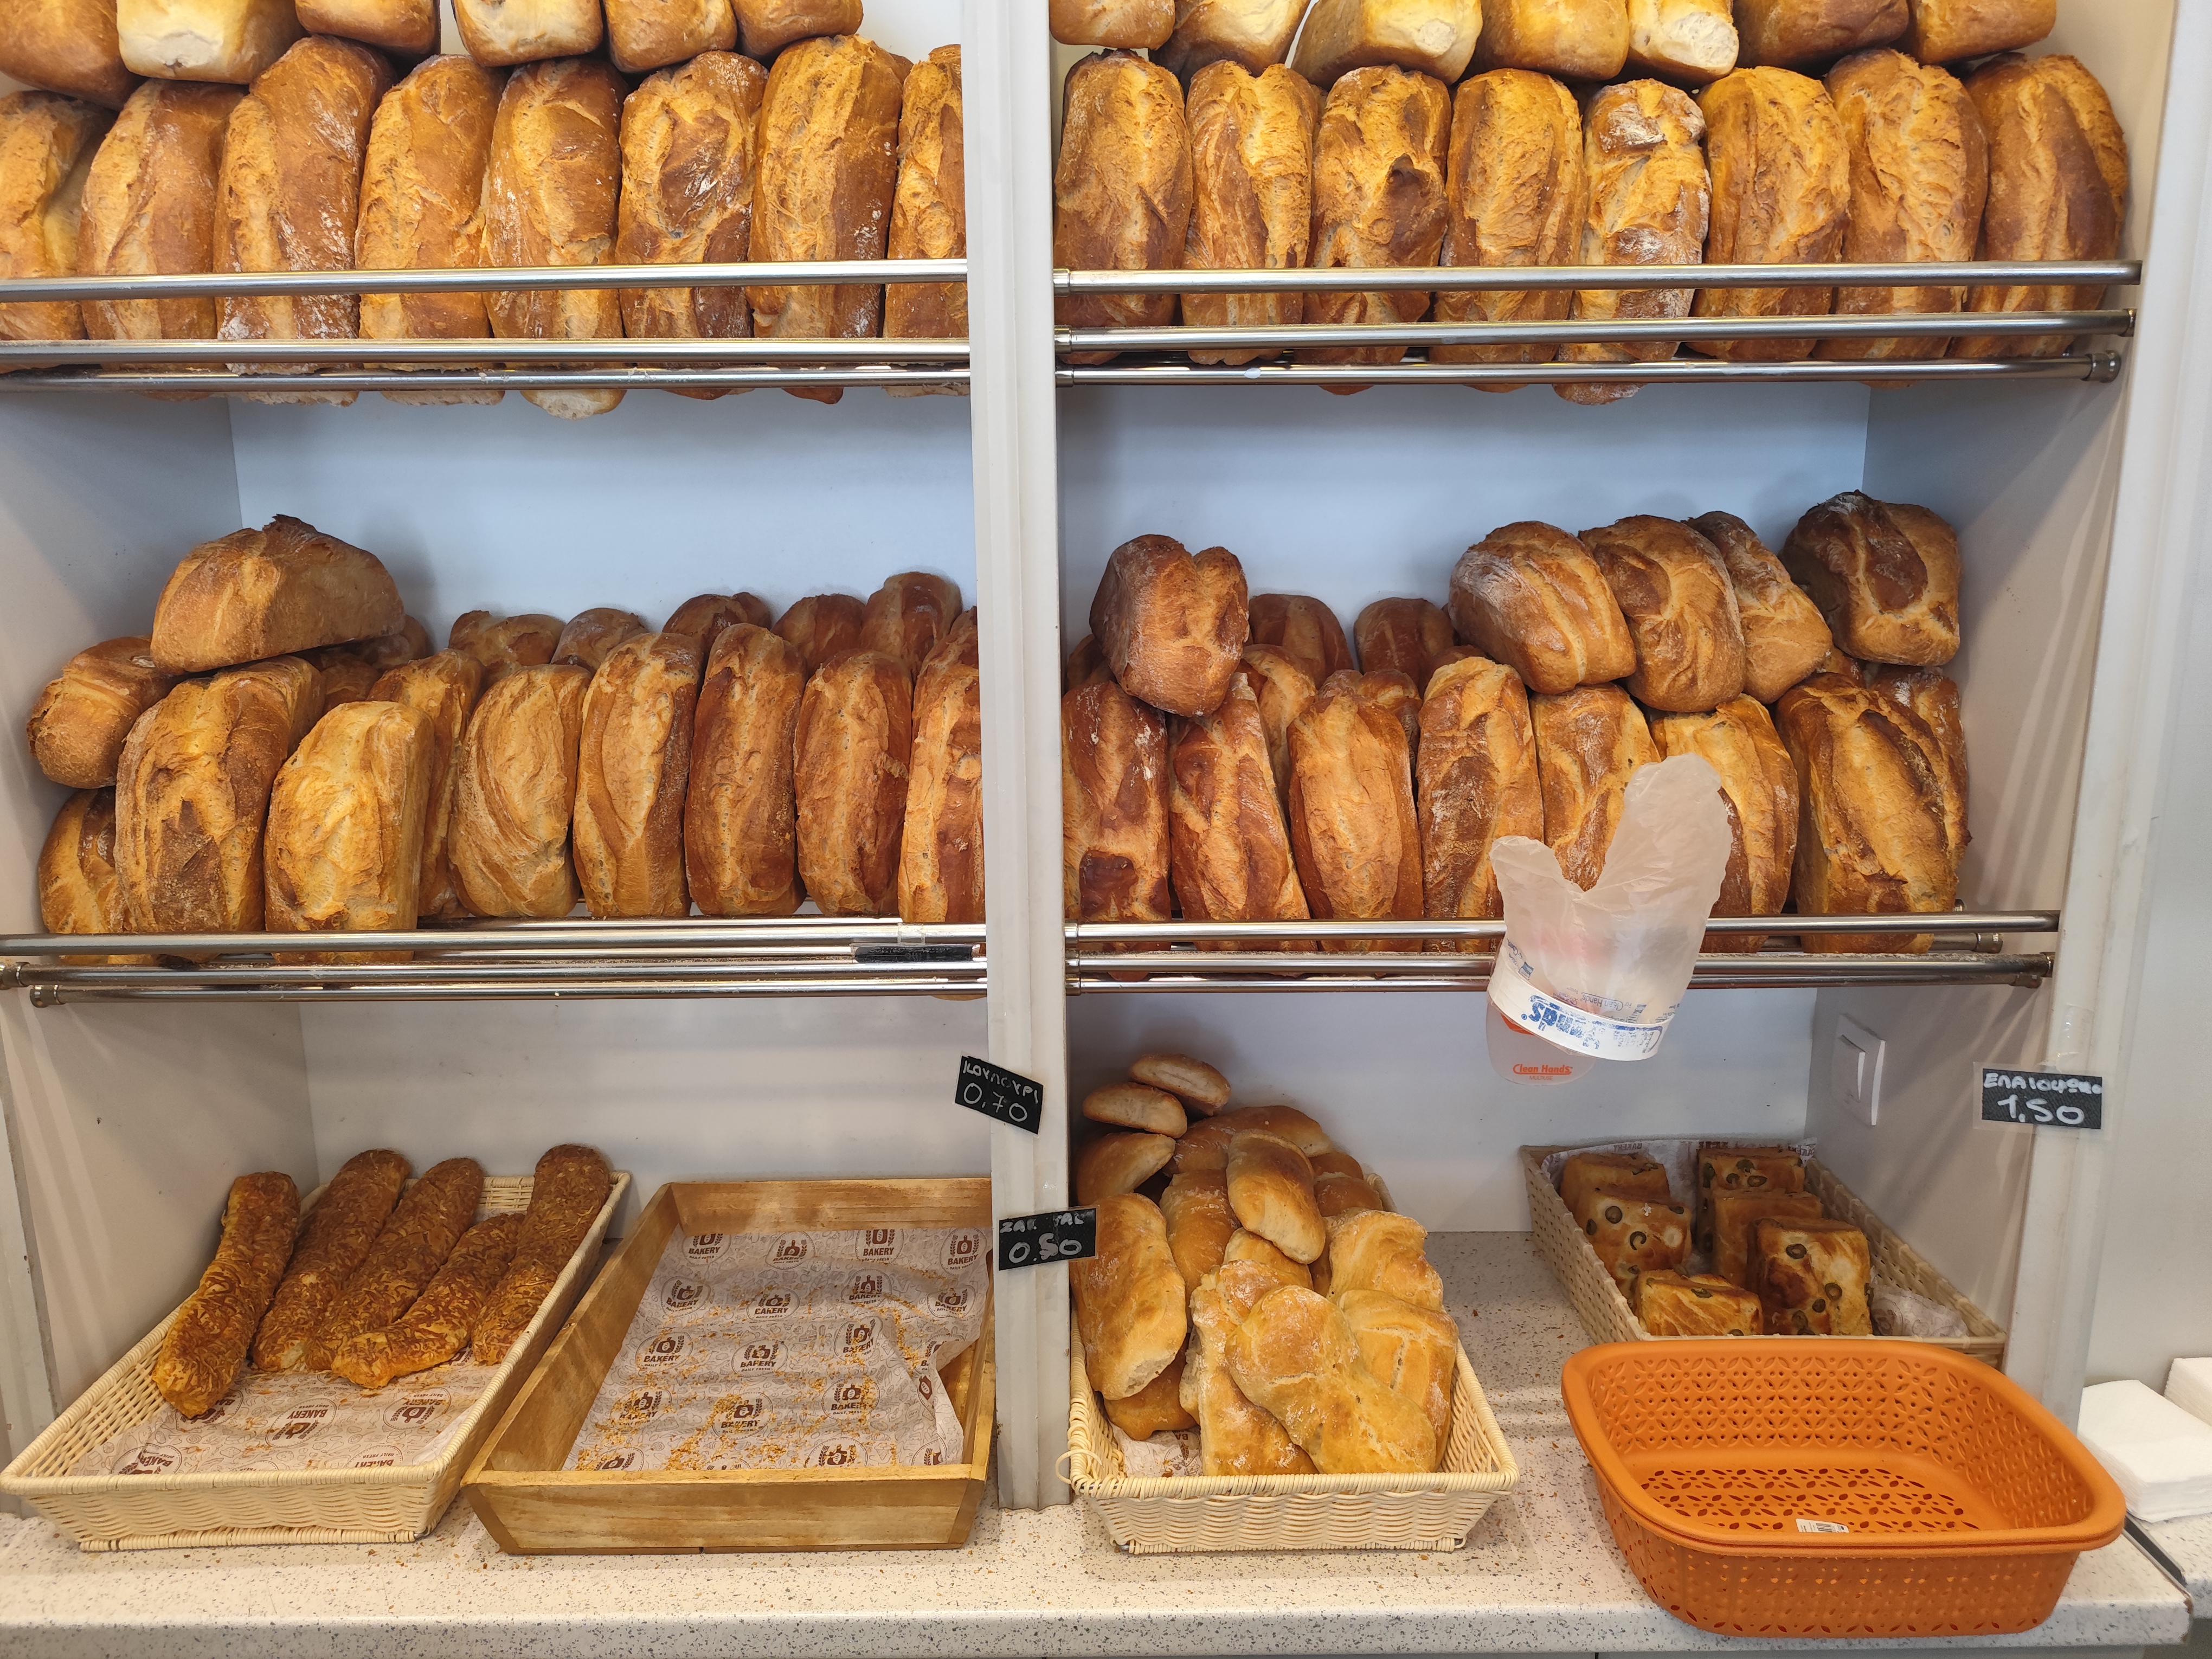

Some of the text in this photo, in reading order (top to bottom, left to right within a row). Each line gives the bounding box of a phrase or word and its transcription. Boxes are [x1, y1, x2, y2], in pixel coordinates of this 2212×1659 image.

[1513, 1063, 1539, 1075] Clean
[963, 1082, 1028, 1122] 0,70
[1997, 1094, 2085, 1124] 1.50
[688, 1246, 721, 1255] BAKERY
[863, 1248, 895, 1256] BAKERY
[947, 1254, 978, 1265] BAKERY
[666, 1297, 699, 1308] BAKERY
[644, 1355, 679, 1363] BAKERY
[286, 1409, 329, 1419] BAKERY
